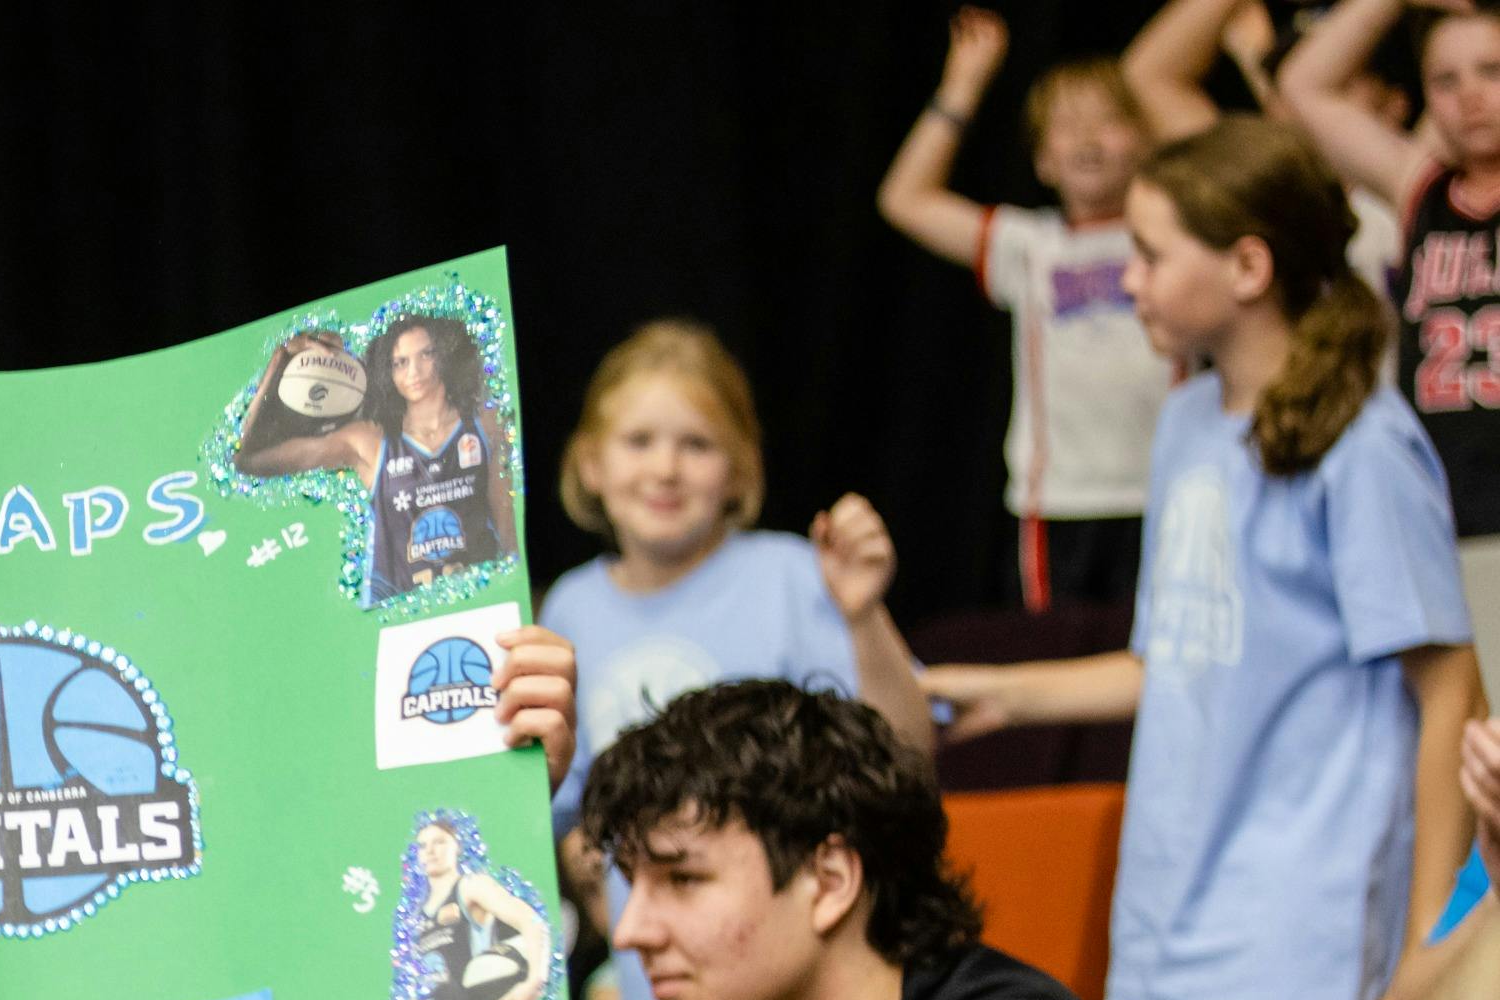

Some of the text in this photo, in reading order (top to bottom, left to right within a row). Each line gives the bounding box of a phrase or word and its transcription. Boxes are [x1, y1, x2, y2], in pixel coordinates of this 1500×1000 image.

[247, 522, 309, 567] #12
[403, 687, 497, 717] CAPITALS
[7, 791, 23, 805] OF
[26, 786, 87, 805] CANBERRA
[342, 866, 381, 913] #5
